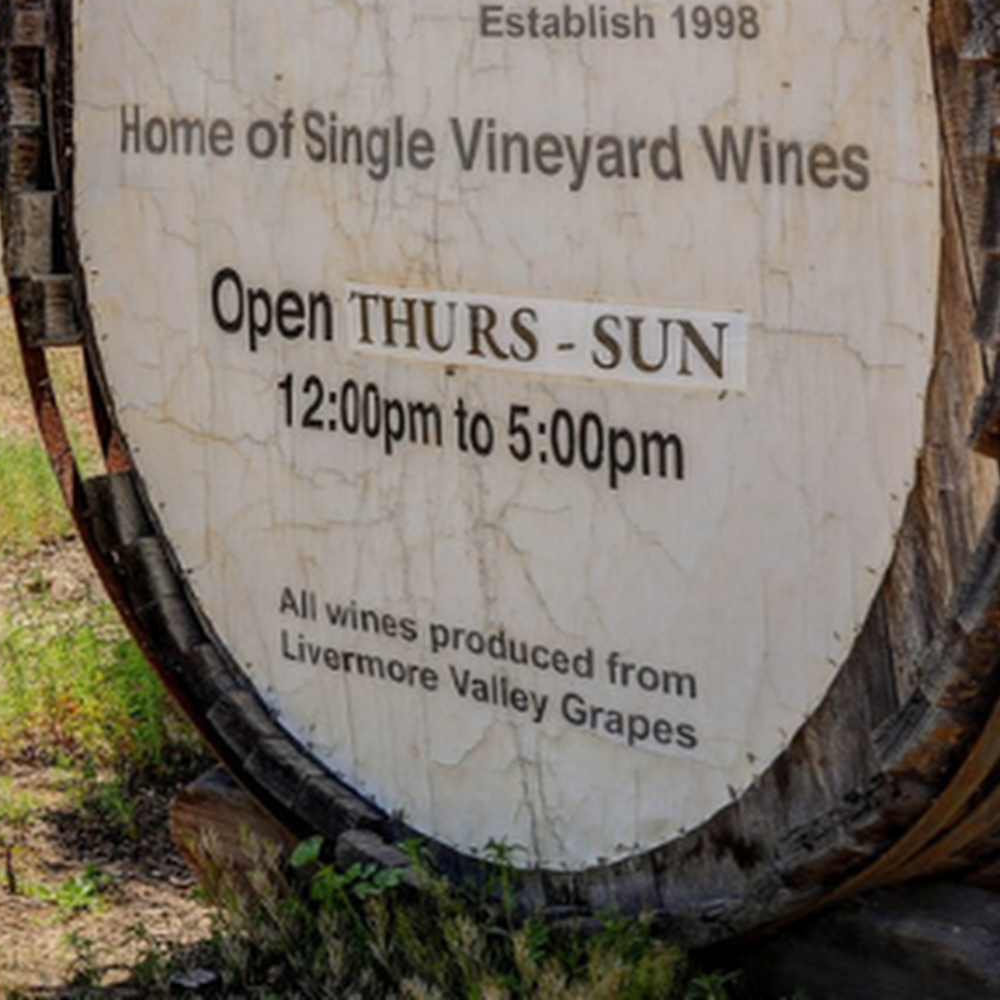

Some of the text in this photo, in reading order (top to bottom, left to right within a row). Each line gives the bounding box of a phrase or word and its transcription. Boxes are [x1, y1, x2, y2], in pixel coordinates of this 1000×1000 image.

[480, 5, 760, 40] Establish 1998
[119, 105, 870, 192] Home of Single Vineyard Wines
[210, 267, 334, 351] Open
[349, 290, 540, 363] THURS
[591, 313, 730, 380] SUN
[277, 373, 685, 489] 12:00pm to 5:00pm
[278, 587, 698, 698] All wines produced from
[281, 630, 698, 750] Livermore Valley Grapes
